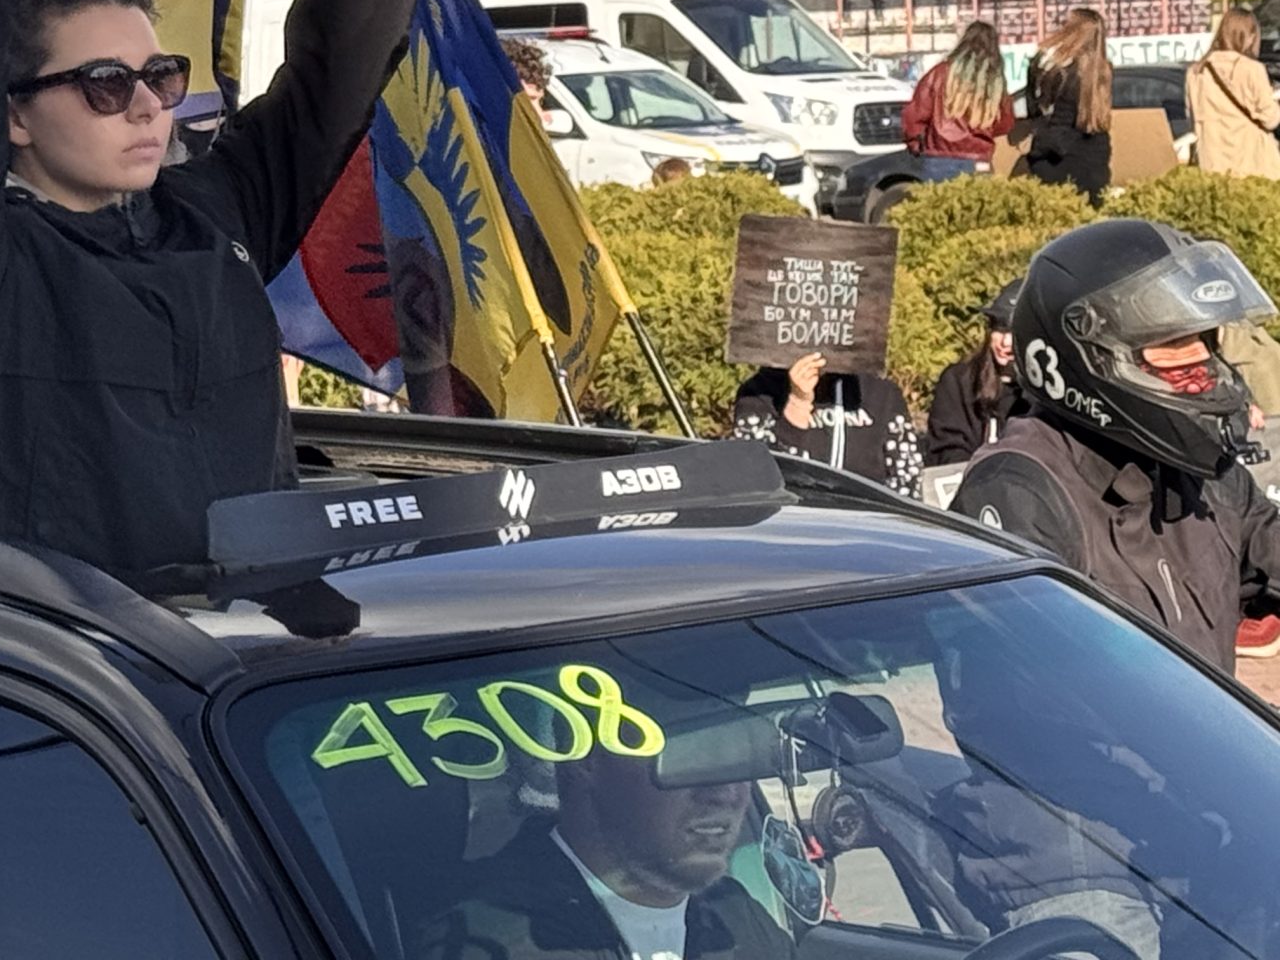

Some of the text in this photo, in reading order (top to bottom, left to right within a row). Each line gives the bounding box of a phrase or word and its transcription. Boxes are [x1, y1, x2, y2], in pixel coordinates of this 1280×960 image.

[783, 258, 824, 273] ТИША
[830, 271, 859, 284] ТАМ
[773, 281, 858, 306] ГОВОРИ
[764, 305, 784, 321] БО
[821, 307, 855, 322] ТАМ
[777, 321, 854, 345] БОЛЯЧЕ
[324, 495, 423, 528] FREE
[311, 664, 666, 788] 4308
